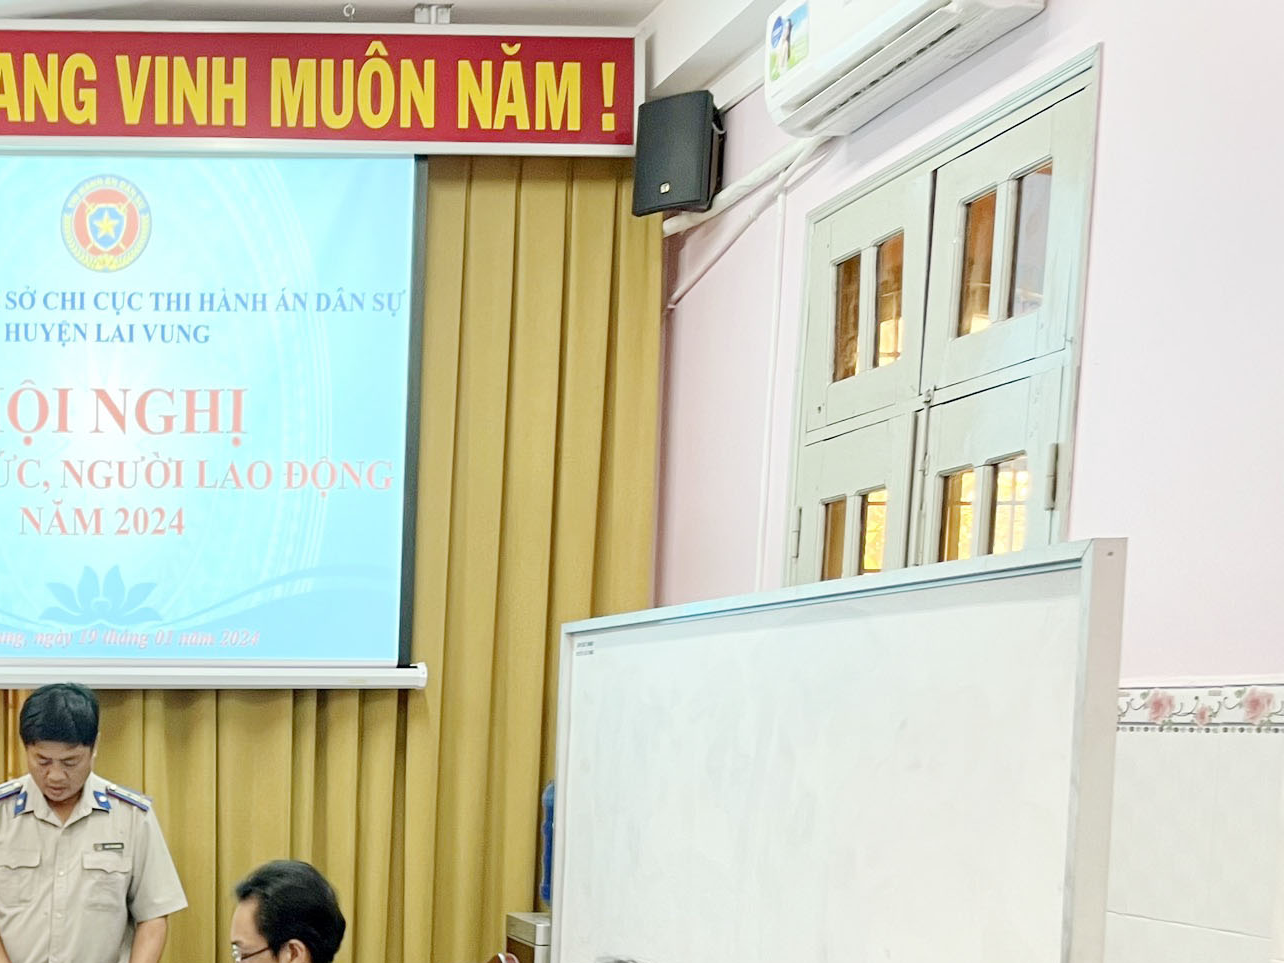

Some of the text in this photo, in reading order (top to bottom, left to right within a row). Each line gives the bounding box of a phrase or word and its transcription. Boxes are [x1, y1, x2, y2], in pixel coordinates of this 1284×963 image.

[116, 54, 242, 127] VINH
[271, 41, 435, 130] MUÔN
[457, 42, 581, 131] NĂM
[5, 284, 37, 310] SỞ
[42, 290, 86, 310] CHI
[93, 291, 143, 316] CỤC
[149, 291, 191, 312] THI
[199, 287, 267, 312] HÀNH
[275, 287, 308, 312] ÁN
[316, 286, 366, 312] DÂN
[371, 289, 407, 317] SỰ
[4, 321, 210, 347] HUYỆN LAI VUNG
[89, 387, 248, 447] NGHỊ
[61, 451, 185, 491] NGƯỜI
[195, 460, 273, 490] LAO
[284, 456, 394, 498] ĐỘNG
[19, 499, 185, 536] NĂM 2024
[220, 630, 260, 647] 2024
